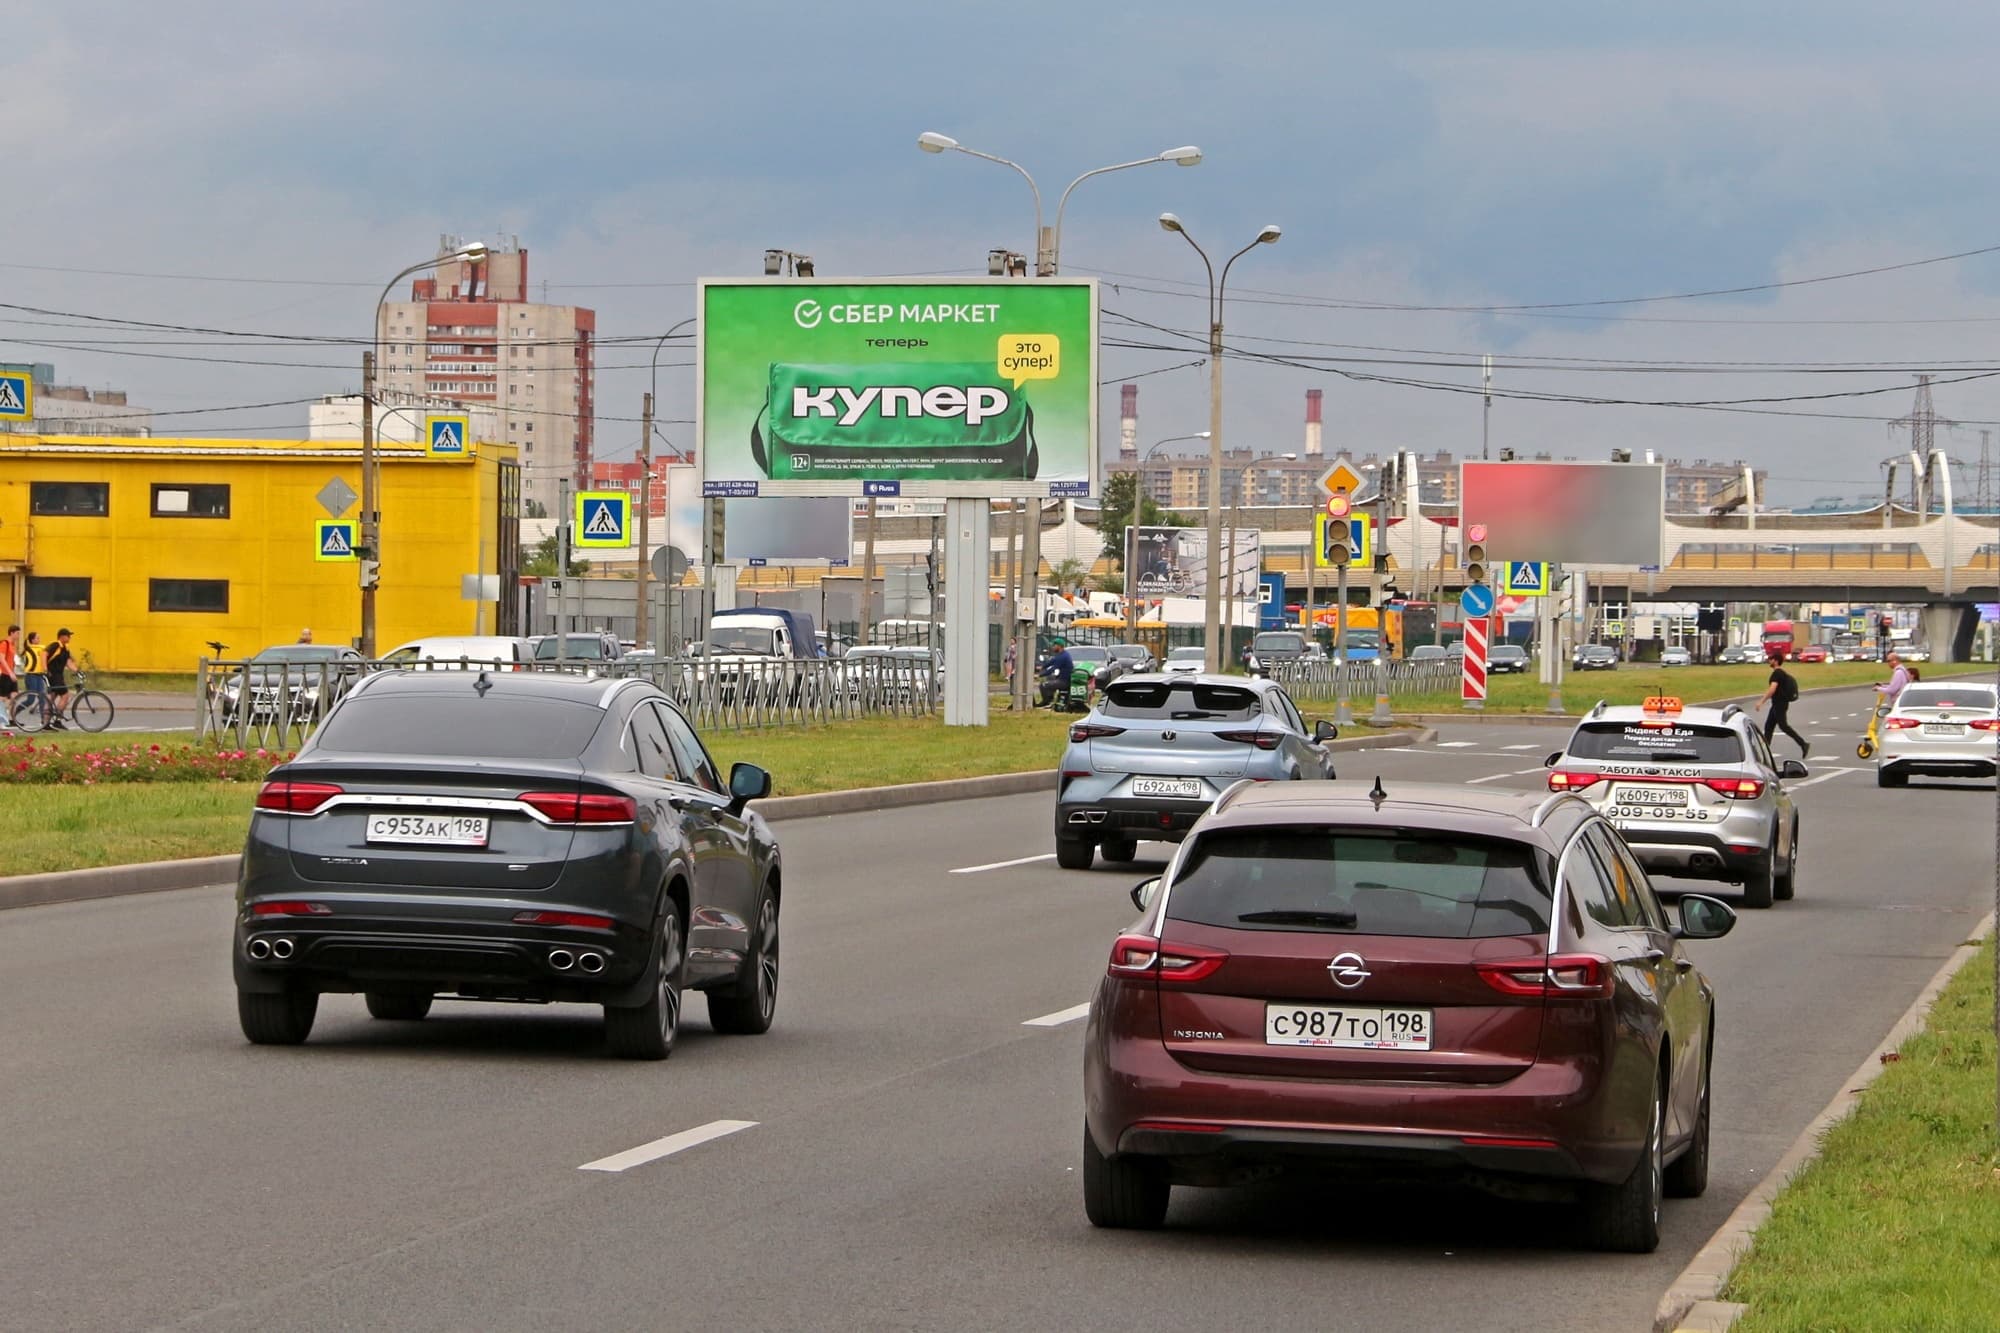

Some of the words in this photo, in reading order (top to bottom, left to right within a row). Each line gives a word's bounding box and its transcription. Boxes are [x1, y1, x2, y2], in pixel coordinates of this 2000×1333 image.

[828, 304, 894, 323] СБЕР
[900, 304, 1000, 323] МАРКЕТ
[865, 337, 929, 349] теперь
[1003, 354, 1054, 370] супер!
[792, 386, 1009, 426] купер
[793, 456, 808, 469] 12+
[1624, 726, 1660, 735] Яндекс
[1674, 728, 1694, 736] Еда
[1599, 765, 1643, 775] РАБОТА
[1661, 768, 1701, 777] ТАКСИ
[1609, 806, 1708, 820] 909-09-55
[455, 819, 482, 833] 198
[1385, 1012, 1424, 1033] 198
[1173, 1029, 1225, 1040] INSIGNIA
[1391, 1032, 1412, 1041] RUS
